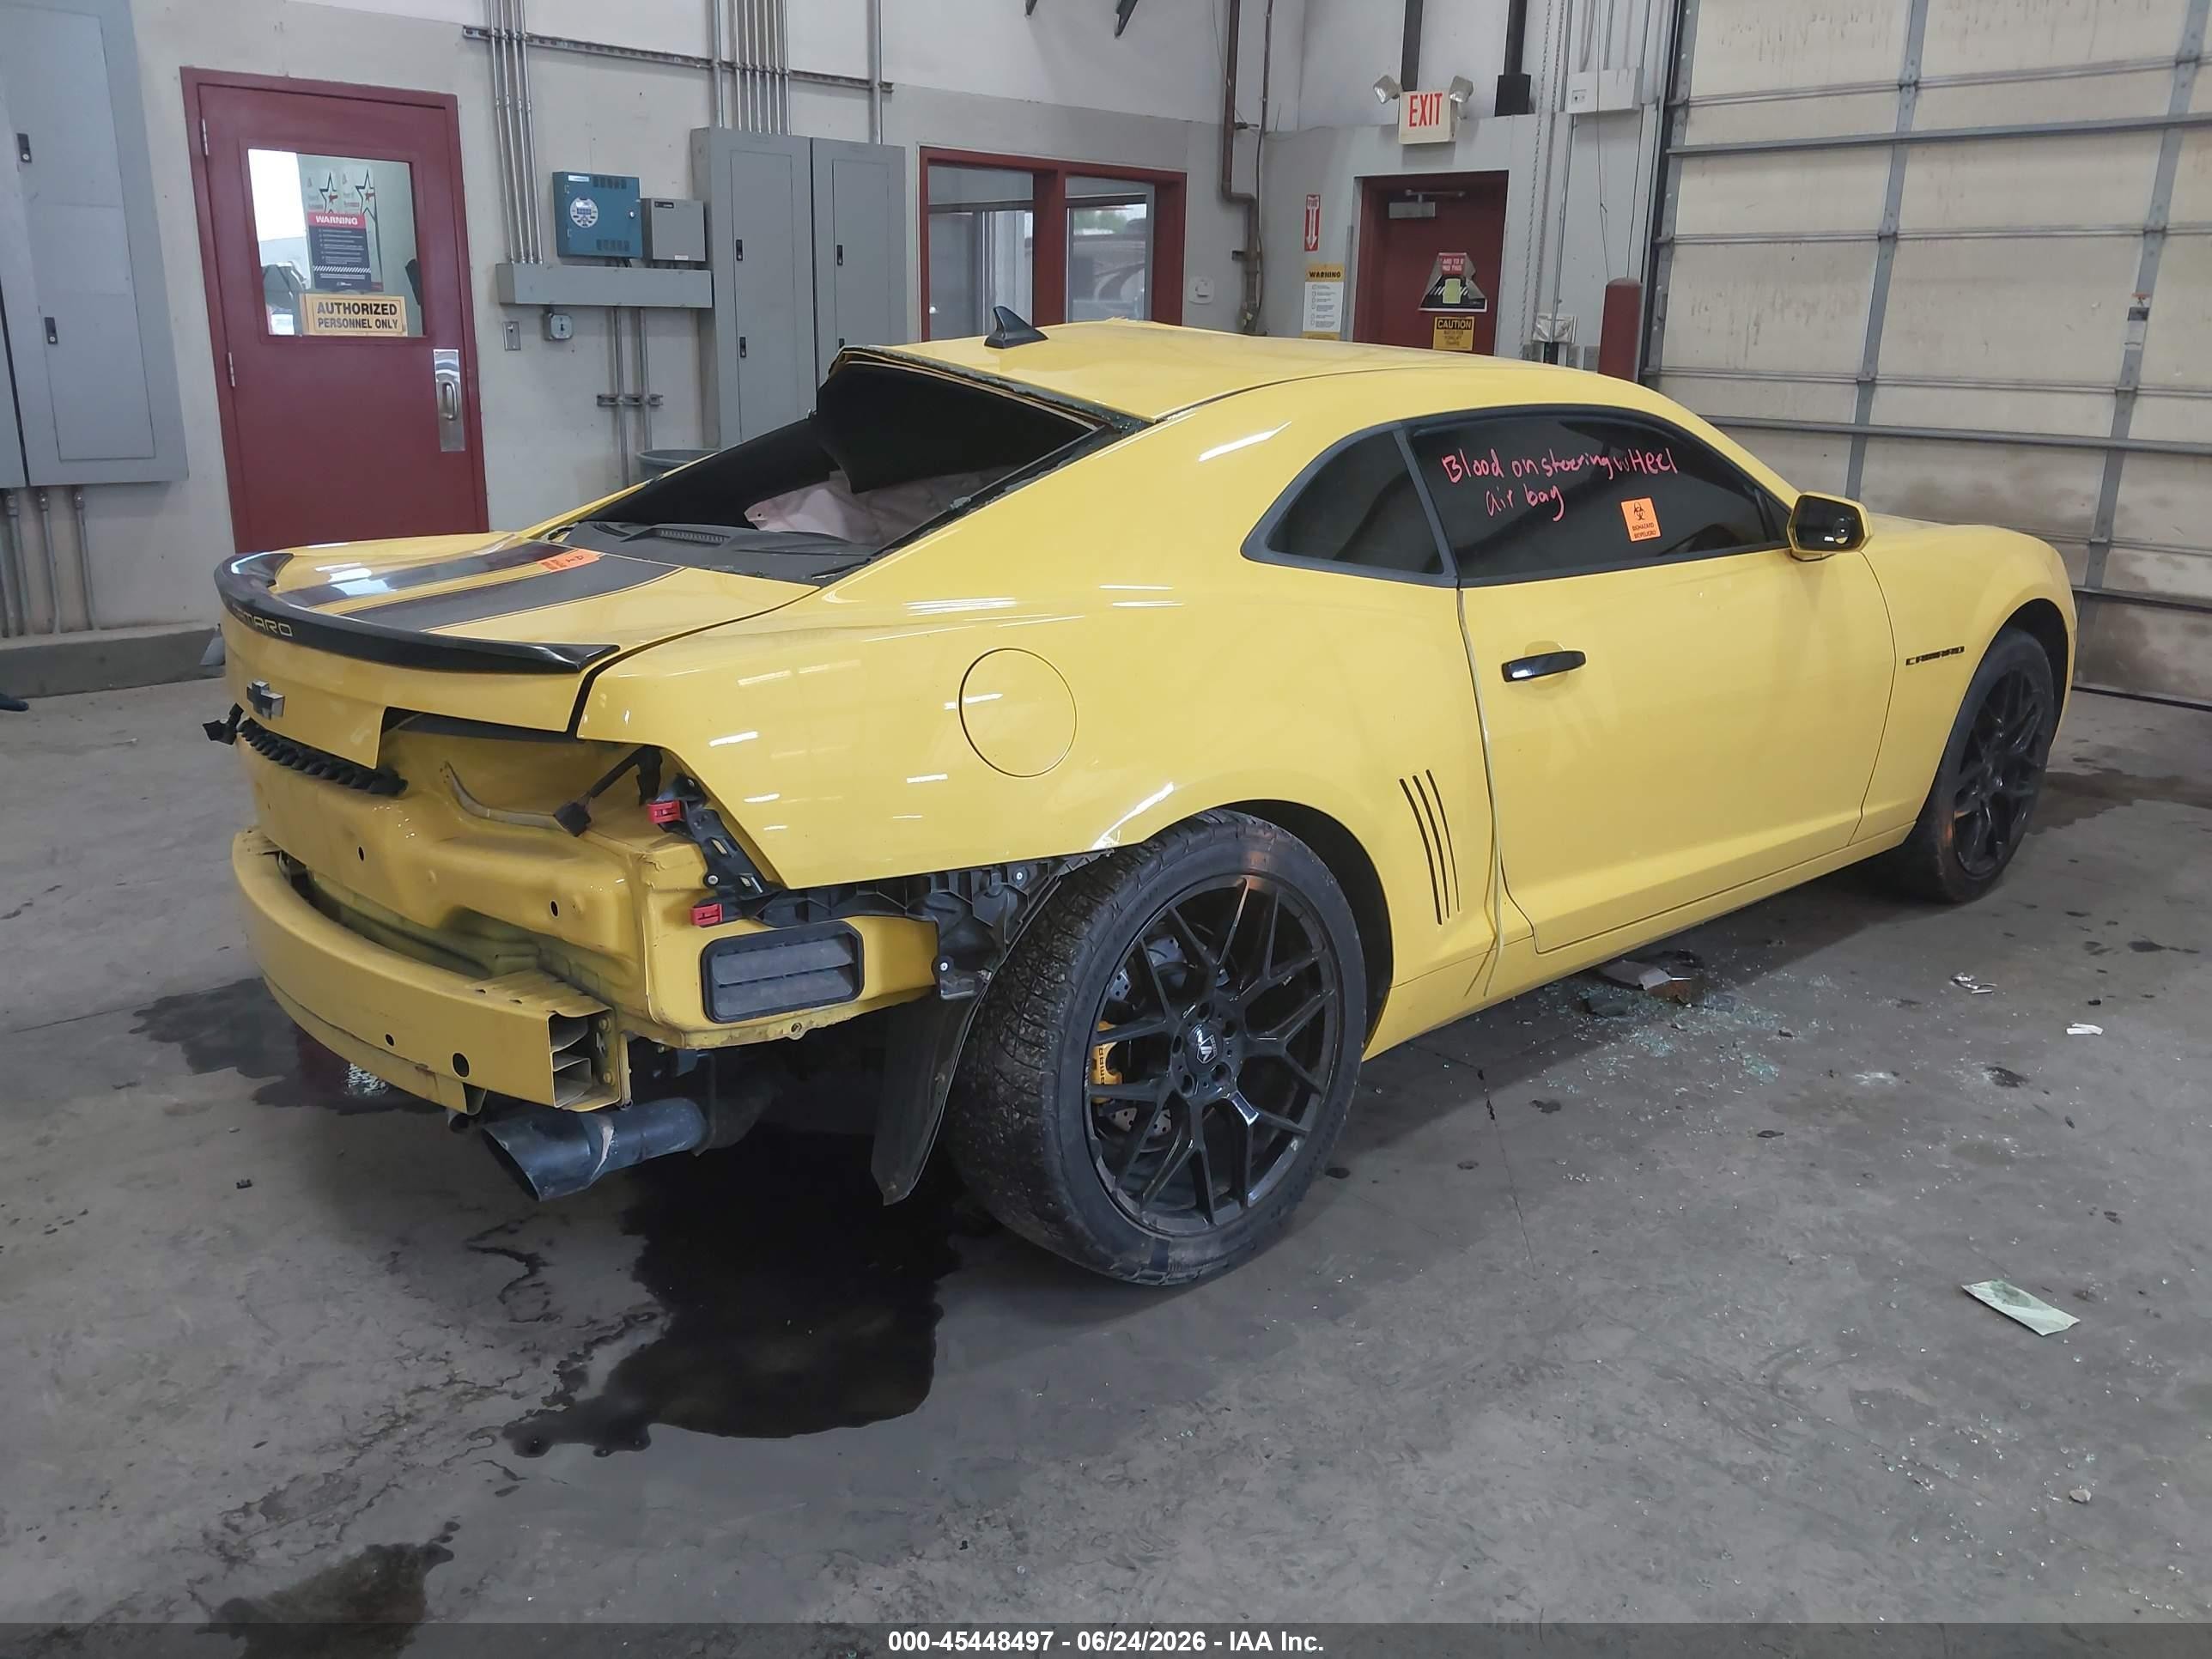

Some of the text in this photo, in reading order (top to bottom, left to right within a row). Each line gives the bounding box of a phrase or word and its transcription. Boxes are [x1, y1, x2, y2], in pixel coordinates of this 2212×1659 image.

[1409, 93, 1443, 127] EXIT
[315, 216, 358, 226] WARNING
[317, 301, 398, 316] AUTHORIZED
[318, 317, 398, 329] PERSONNEL ONLY
[1437, 319, 1472, 329] CAUTION
[1442, 448, 1504, 483] Blood
[1511, 457, 1540, 478] on
